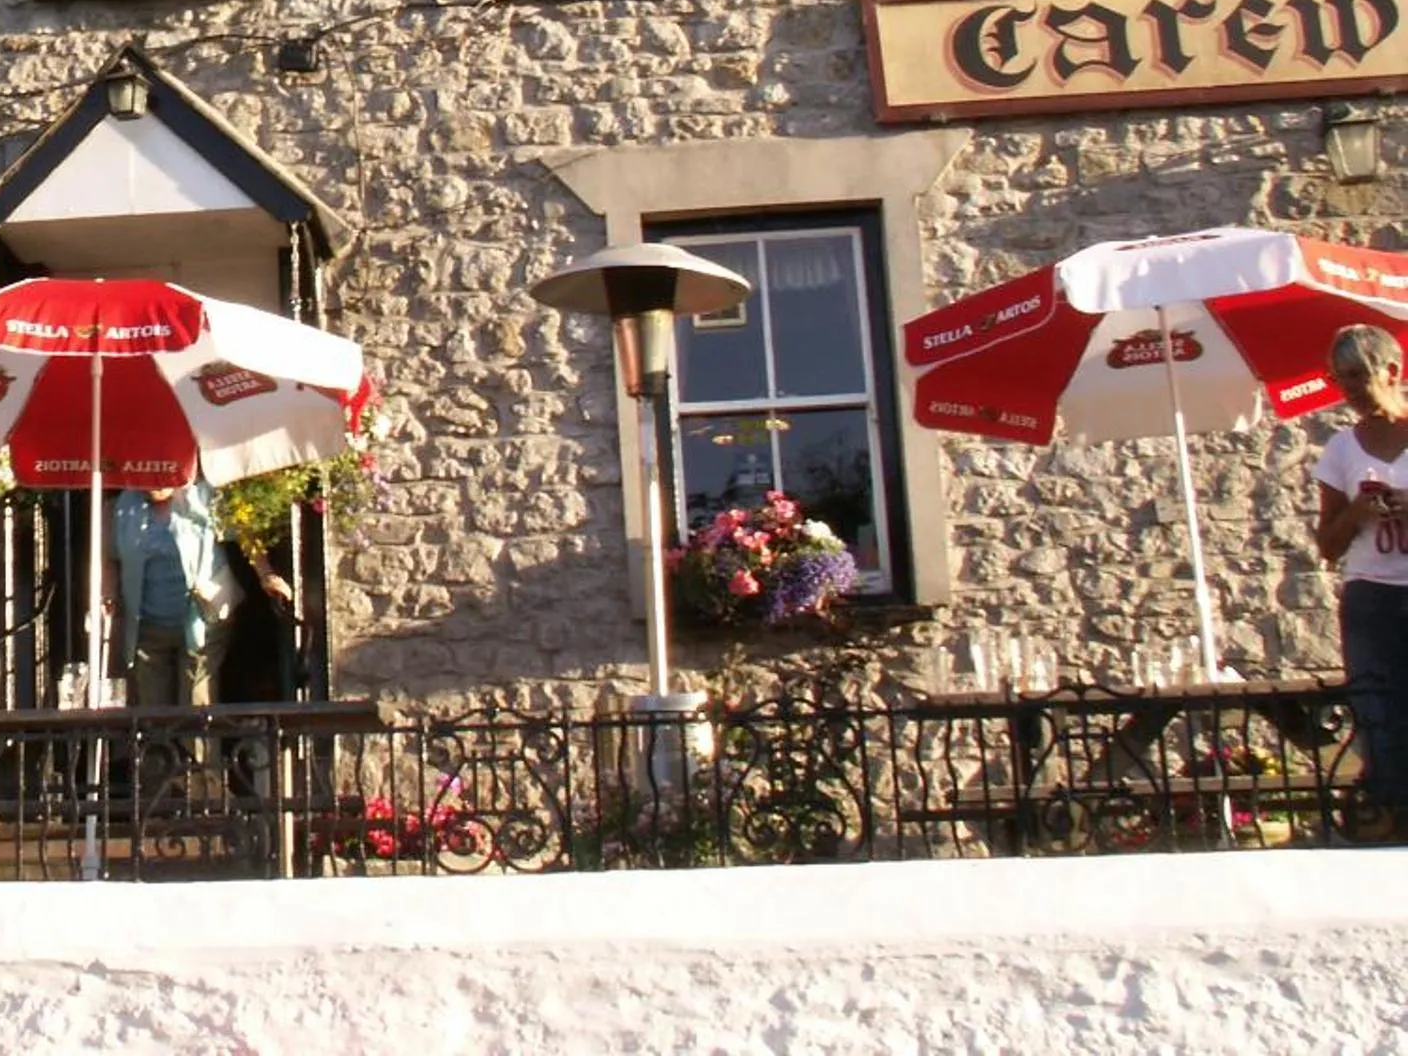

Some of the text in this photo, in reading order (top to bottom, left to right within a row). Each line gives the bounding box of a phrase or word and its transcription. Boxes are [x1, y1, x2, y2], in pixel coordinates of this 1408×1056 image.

[5, 319, 171, 340] STELLA ARTOIS
[923, 295, 1041, 350] STELLA ARTOIS
